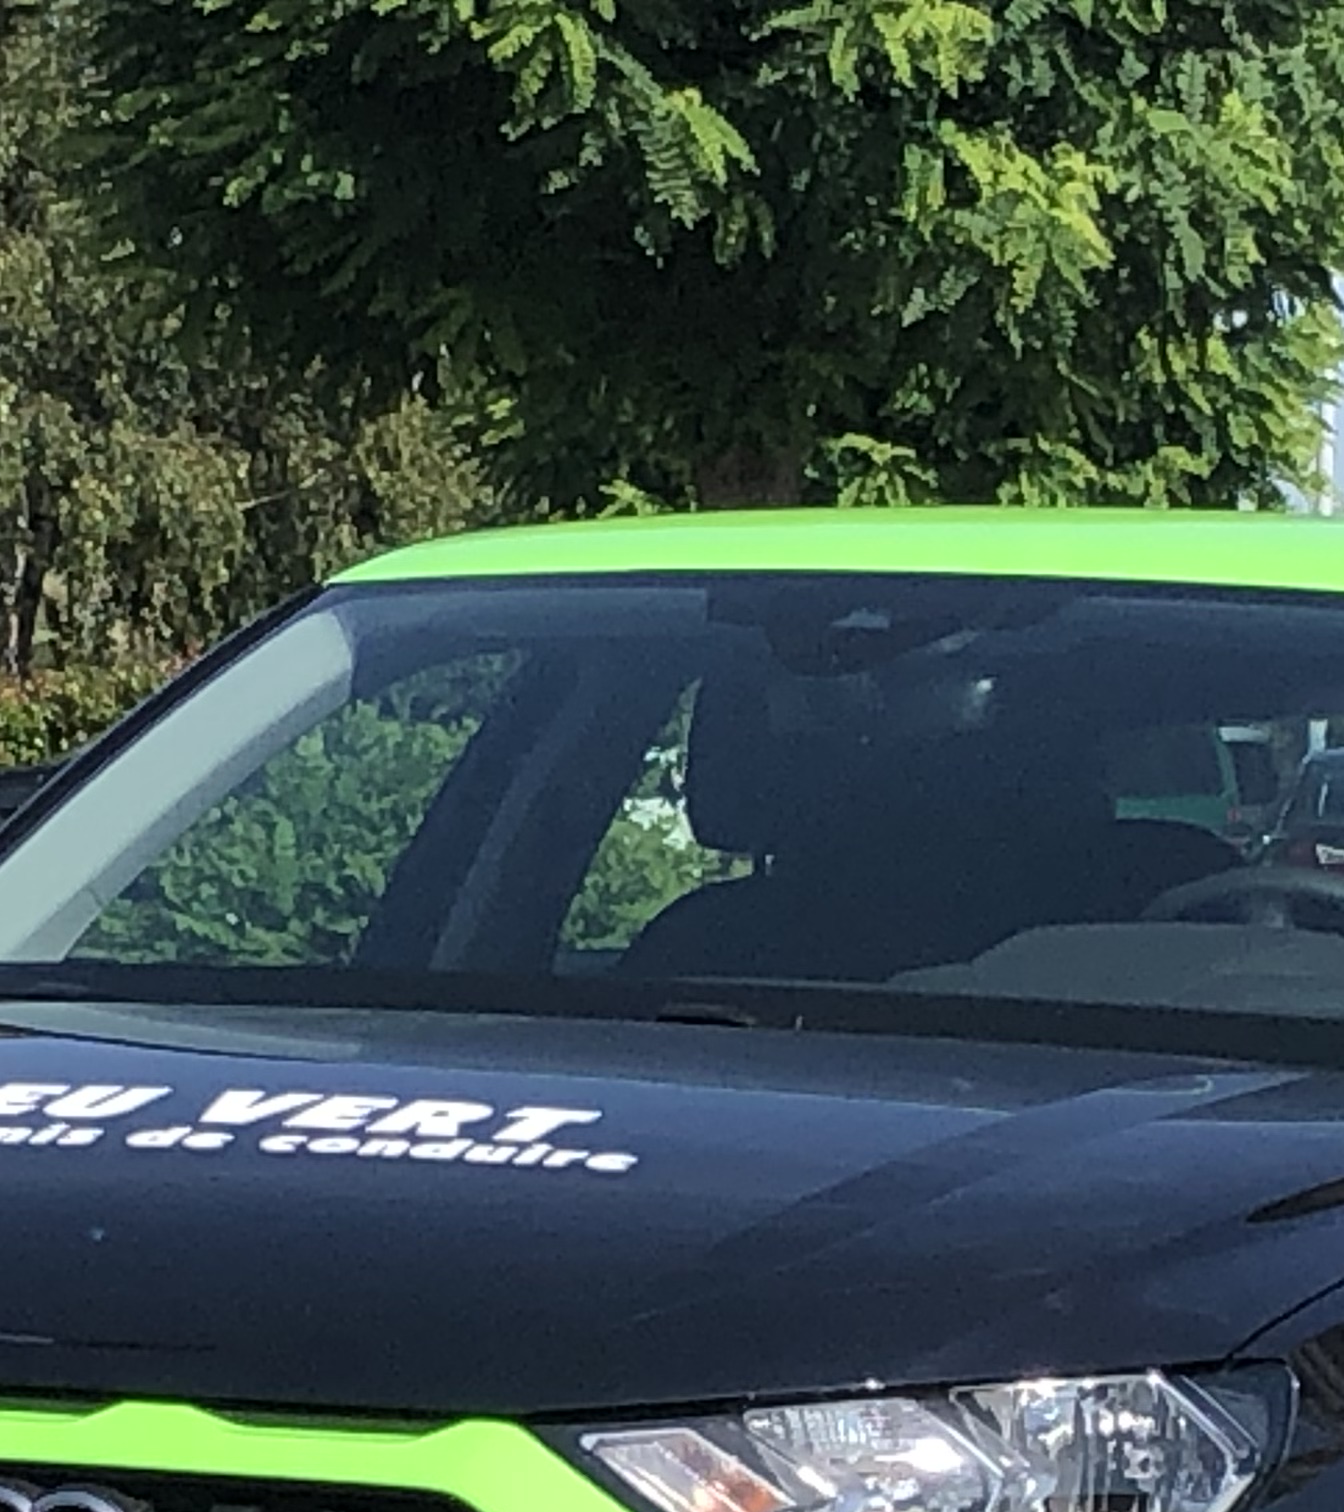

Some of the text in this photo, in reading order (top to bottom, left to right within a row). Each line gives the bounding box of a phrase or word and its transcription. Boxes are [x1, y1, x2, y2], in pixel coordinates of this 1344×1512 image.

[198, 1089, 603, 1144] VERT
[126, 1126, 234, 1151] de
[258, 1133, 639, 1174] conduire
